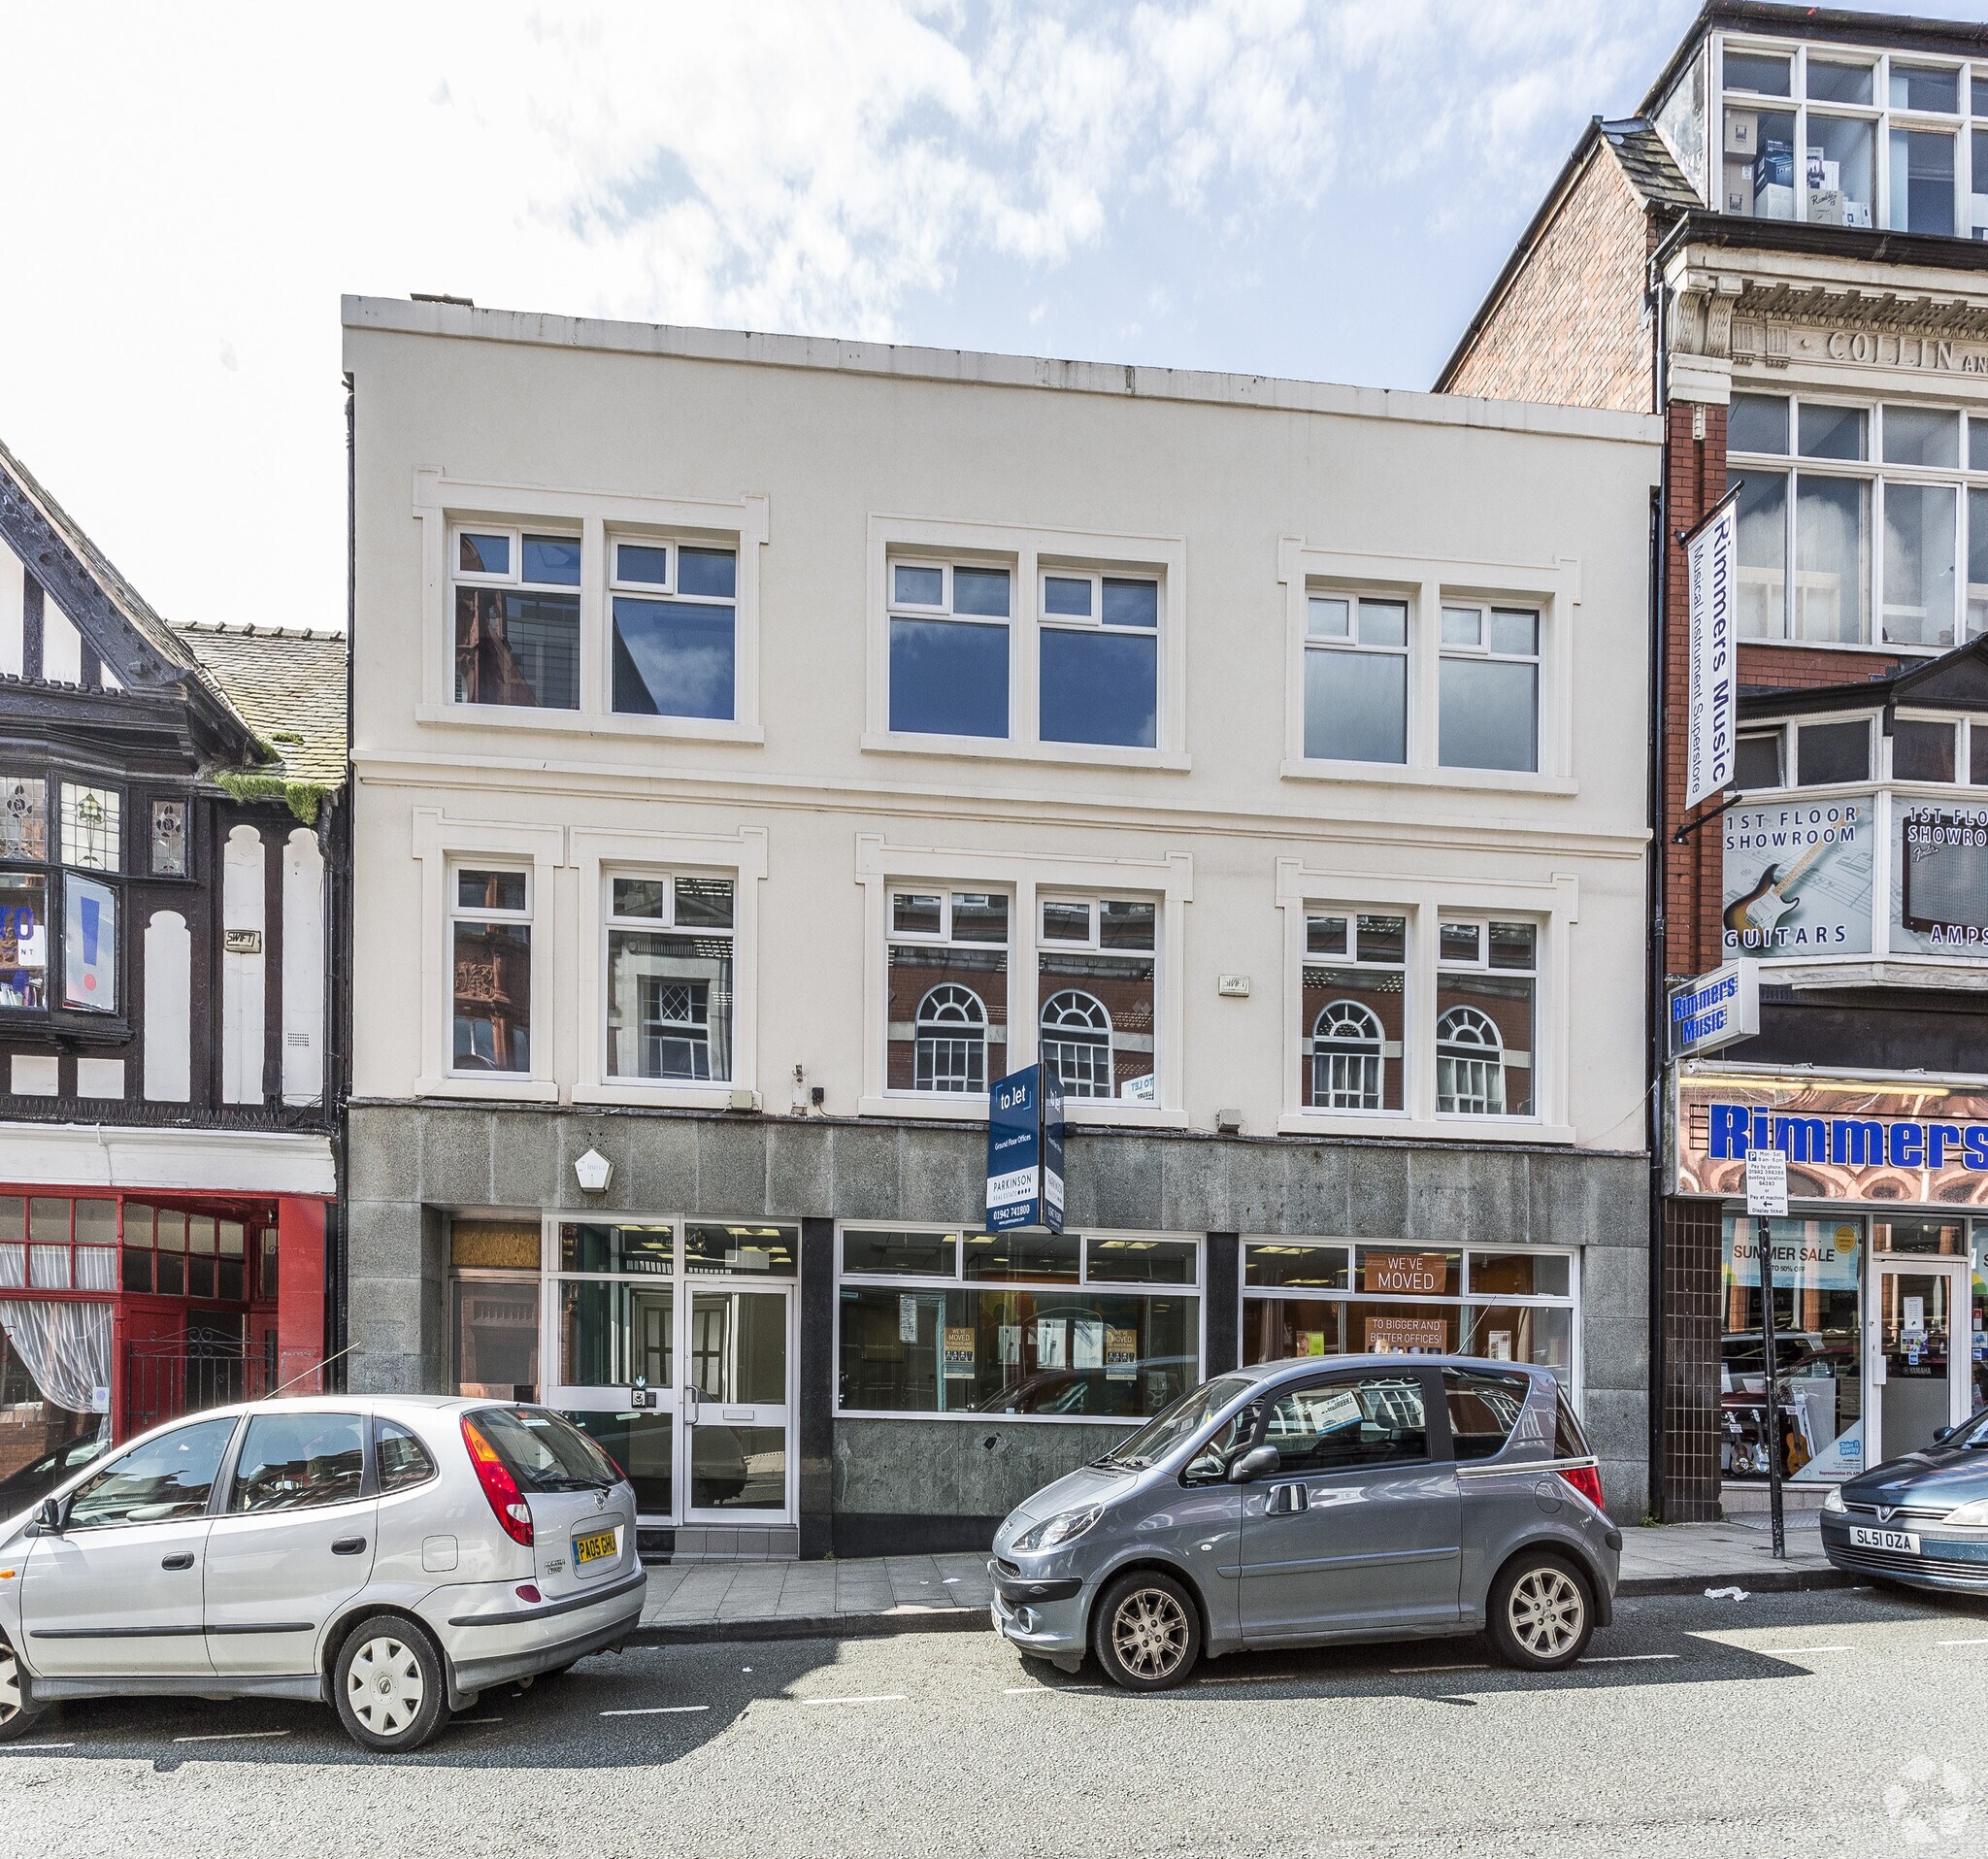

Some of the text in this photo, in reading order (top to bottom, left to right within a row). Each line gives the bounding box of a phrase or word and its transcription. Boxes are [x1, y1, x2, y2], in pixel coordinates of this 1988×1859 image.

[1829, 331, 1955, 370] COLLIN
[1713, 515, 1731, 782] Rimmers Music
[1691, 544, 1705, 794] Musical Instrument Superstore
[1726, 807, 1858, 830] 1ST FLOOR
[1909, 807, 1941, 823] 1ST
[1726, 826, 1855, 850] SHOWROOM
[227, 932, 254, 945] SWIFT
[1724, 924, 1846, 948] GUITARS
[1673, 977, 1737, 1022] Rimmers
[1682, 1009, 1725, 1045] Music
[1001, 1084, 1026, 1110] to let
[995, 1134, 1032, 1150] Ground Floor Offices
[1708, 1103, 1988, 1172] Rimmers
[993, 1173, 1032, 1192] PARKINSON
[993, 1204, 1030, 1220] 01942 741800
[1388, 1257, 1424, 1270] WE'VE
[1799, 1247, 1836, 1262] SALE
[1378, 1273, 1434, 1289] MOVED
[1373, 1319, 1441, 1331] TO BIGGER AND
[1370, 1332, 1442, 1344] BETTER OFFICES!
[579, 1538, 601, 1560] PA05
[1857, 1529, 1911, 1549] SL51 OZA
